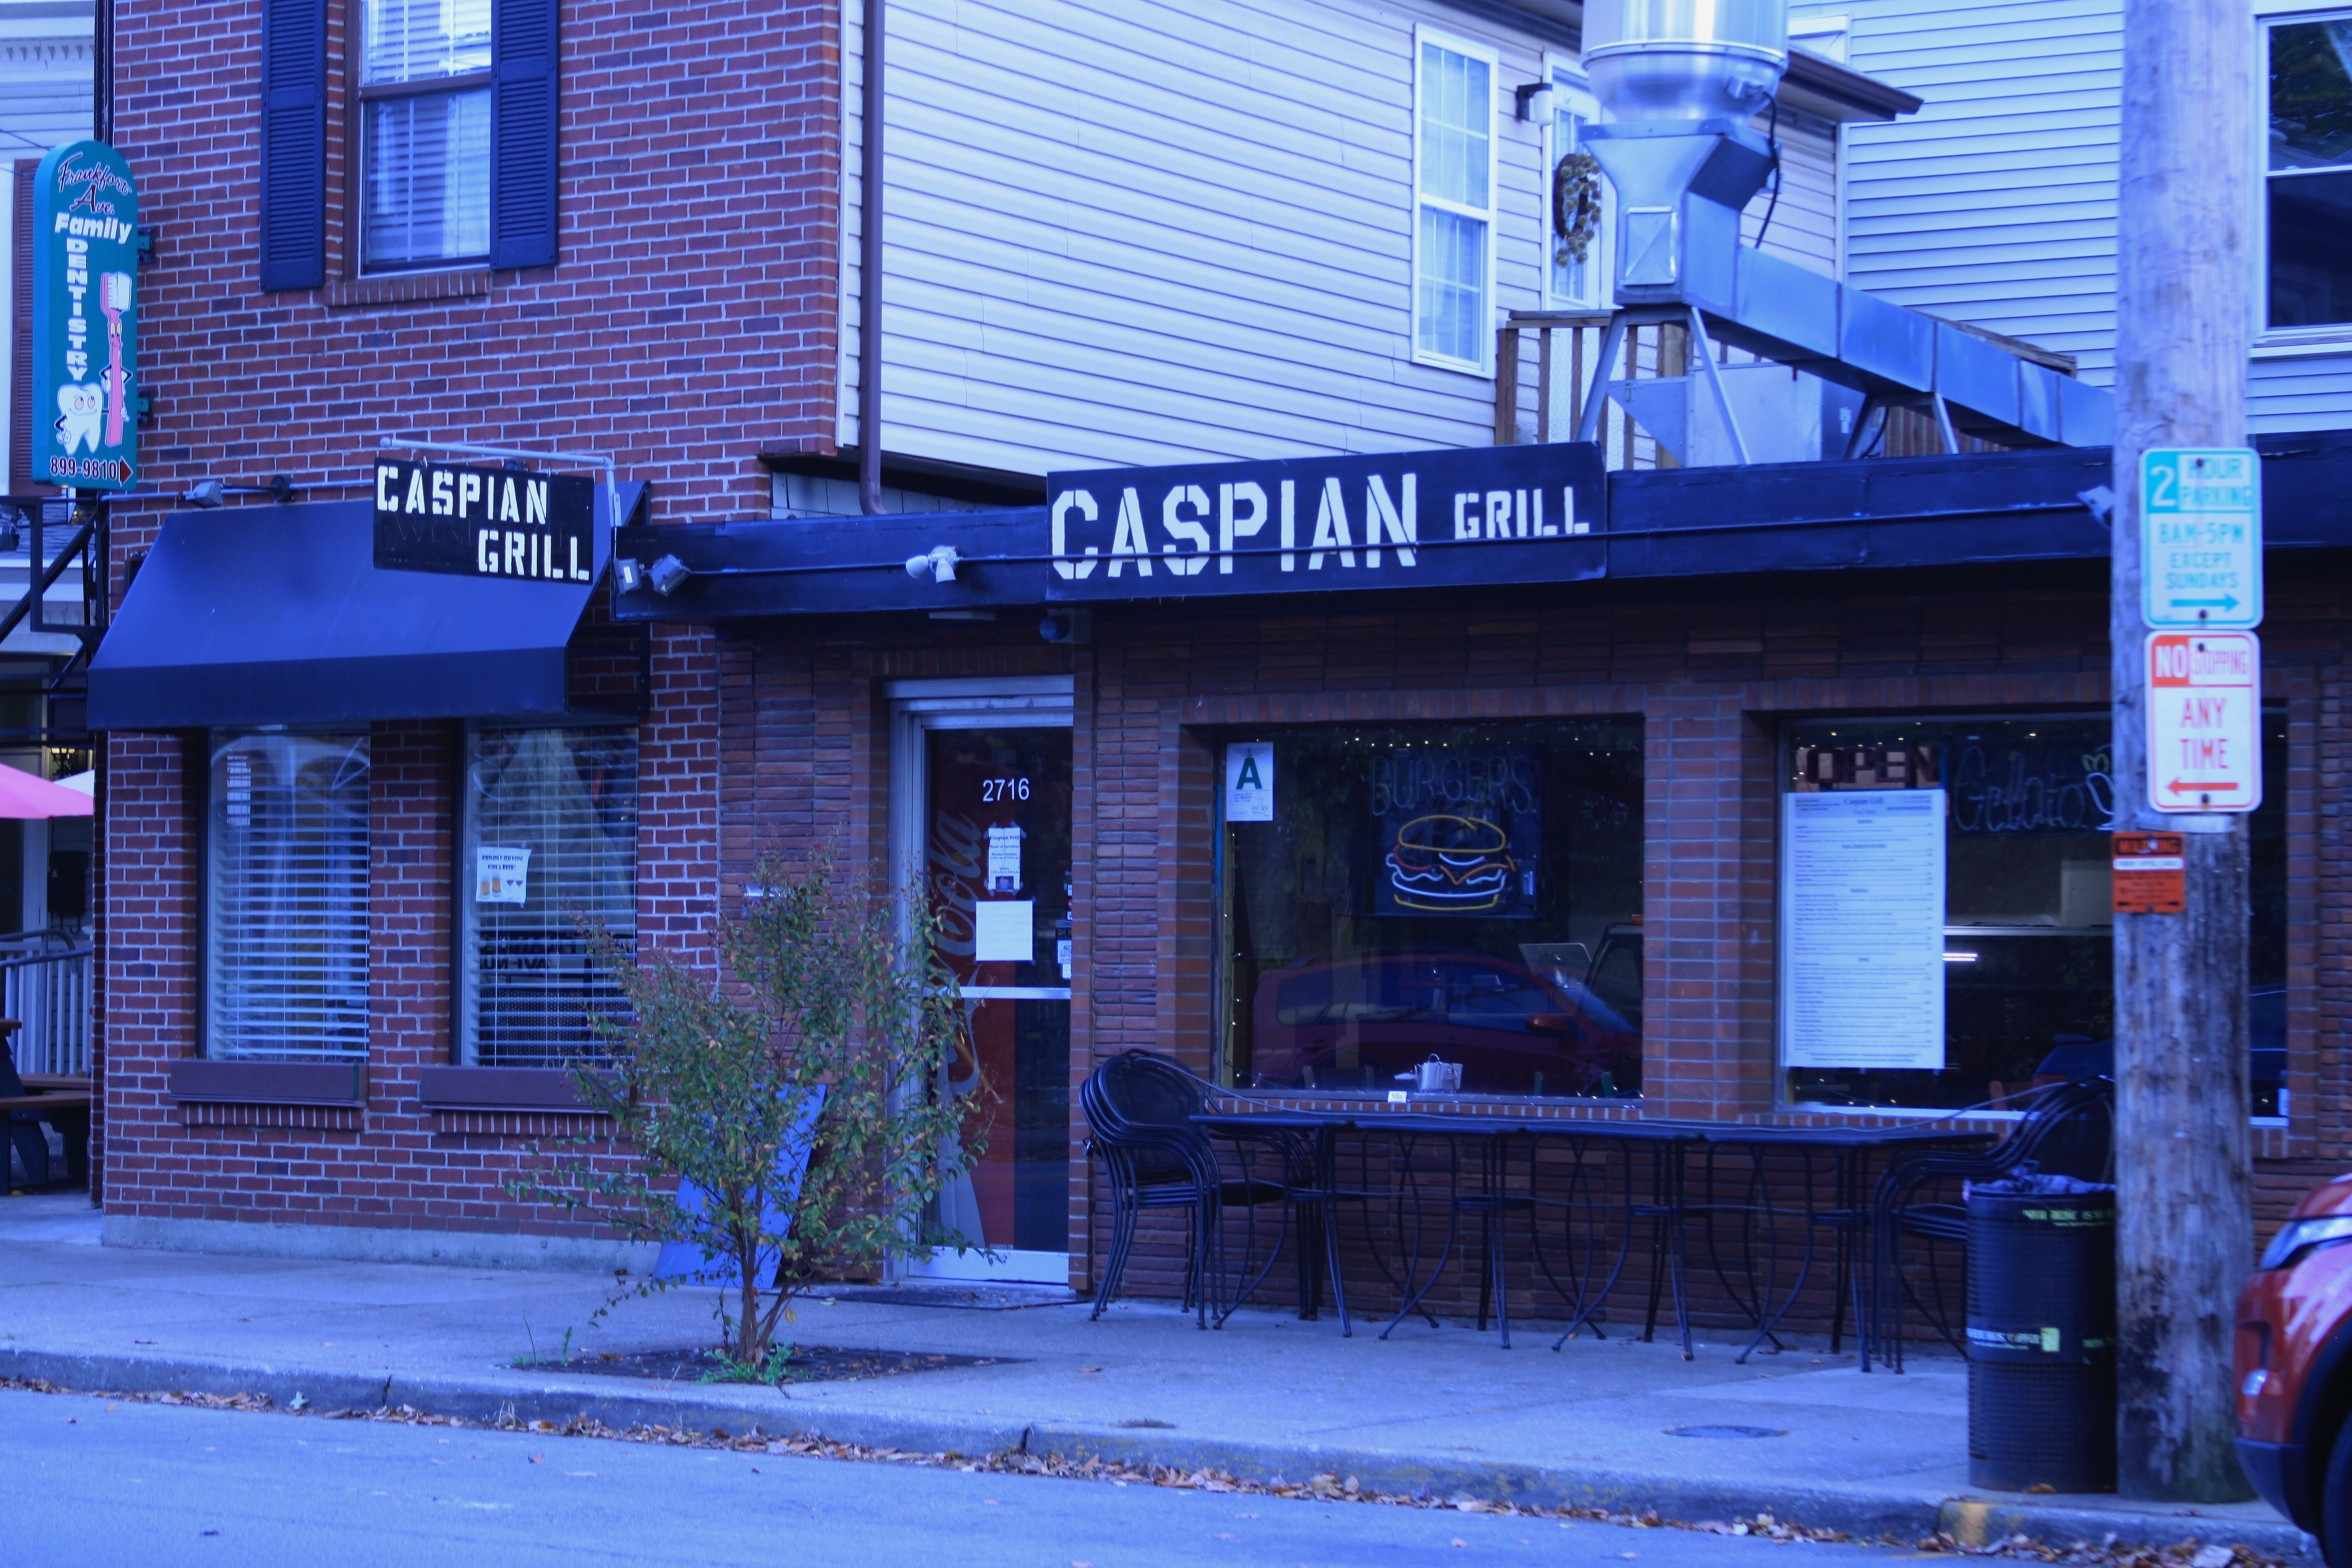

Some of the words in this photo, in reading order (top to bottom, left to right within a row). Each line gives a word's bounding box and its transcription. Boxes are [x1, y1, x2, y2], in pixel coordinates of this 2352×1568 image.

[57, 152, 132, 195] Frankfort
[70, 184, 115, 213] Ave.
[54, 212, 133, 244] Family
[66, 238, 88, 381] DENTISTRY
[50, 456, 118, 481] 899-9810
[2151, 465, 2176, 507] 2
[2187, 458, 2243, 479] HOUR
[377, 465, 547, 525] CASPIAN
[2180, 486, 2253, 507] PARKING
[1051, 472, 1418, 580] CASPIAN
[1453, 486, 1590, 540] GRILL
[478, 528, 590, 582] GRILL
[2169, 552, 2233, 569] EXCEPT
[2165, 571, 2240, 589] SUNDAYS
[2155, 644, 2189, 678] NO
[2179, 697, 2228, 729] ANY
[1806, 748, 1941, 784] OPEN
[2180, 738, 2230, 770] TIME
[1235, 757, 1263, 790] A
[1371, 754, 1535, 817] BURGERS
[982, 778, 1030, 803] 2716
